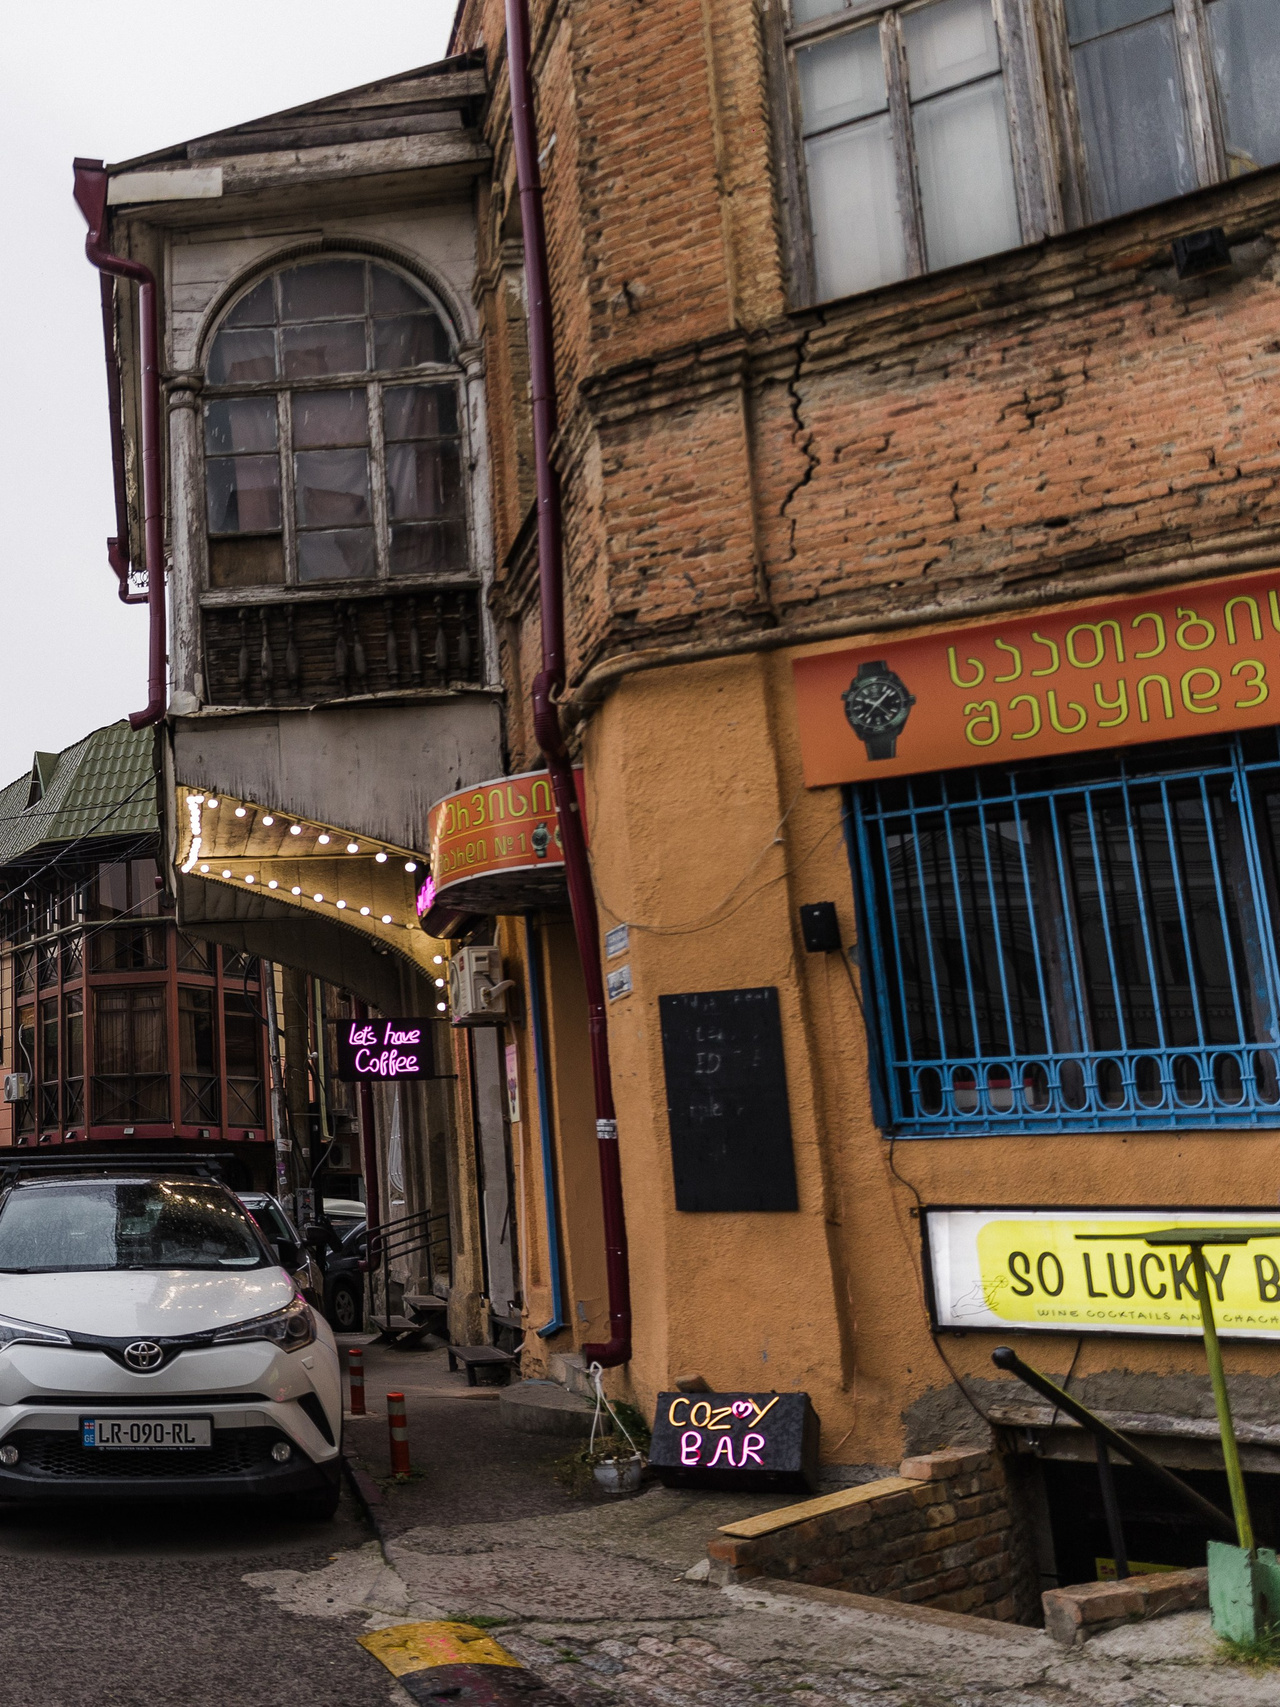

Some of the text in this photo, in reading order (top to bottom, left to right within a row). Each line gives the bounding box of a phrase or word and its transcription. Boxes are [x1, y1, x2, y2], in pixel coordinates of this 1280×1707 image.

[383, 1021, 420, 1046] have
[355, 1048, 420, 1076] Coffee
[1008, 1251, 1064, 1297] SO
[1082, 1252, 1231, 1302] LUCKY
[1037, 1308, 1079, 1318] WINE
[1086, 1309, 1171, 1321] COCKTAILS
[668, 1396, 780, 1431] COZY
[98, 1423, 196, 1444] LR-090-RL
[680, 1431, 766, 1468] BAR
